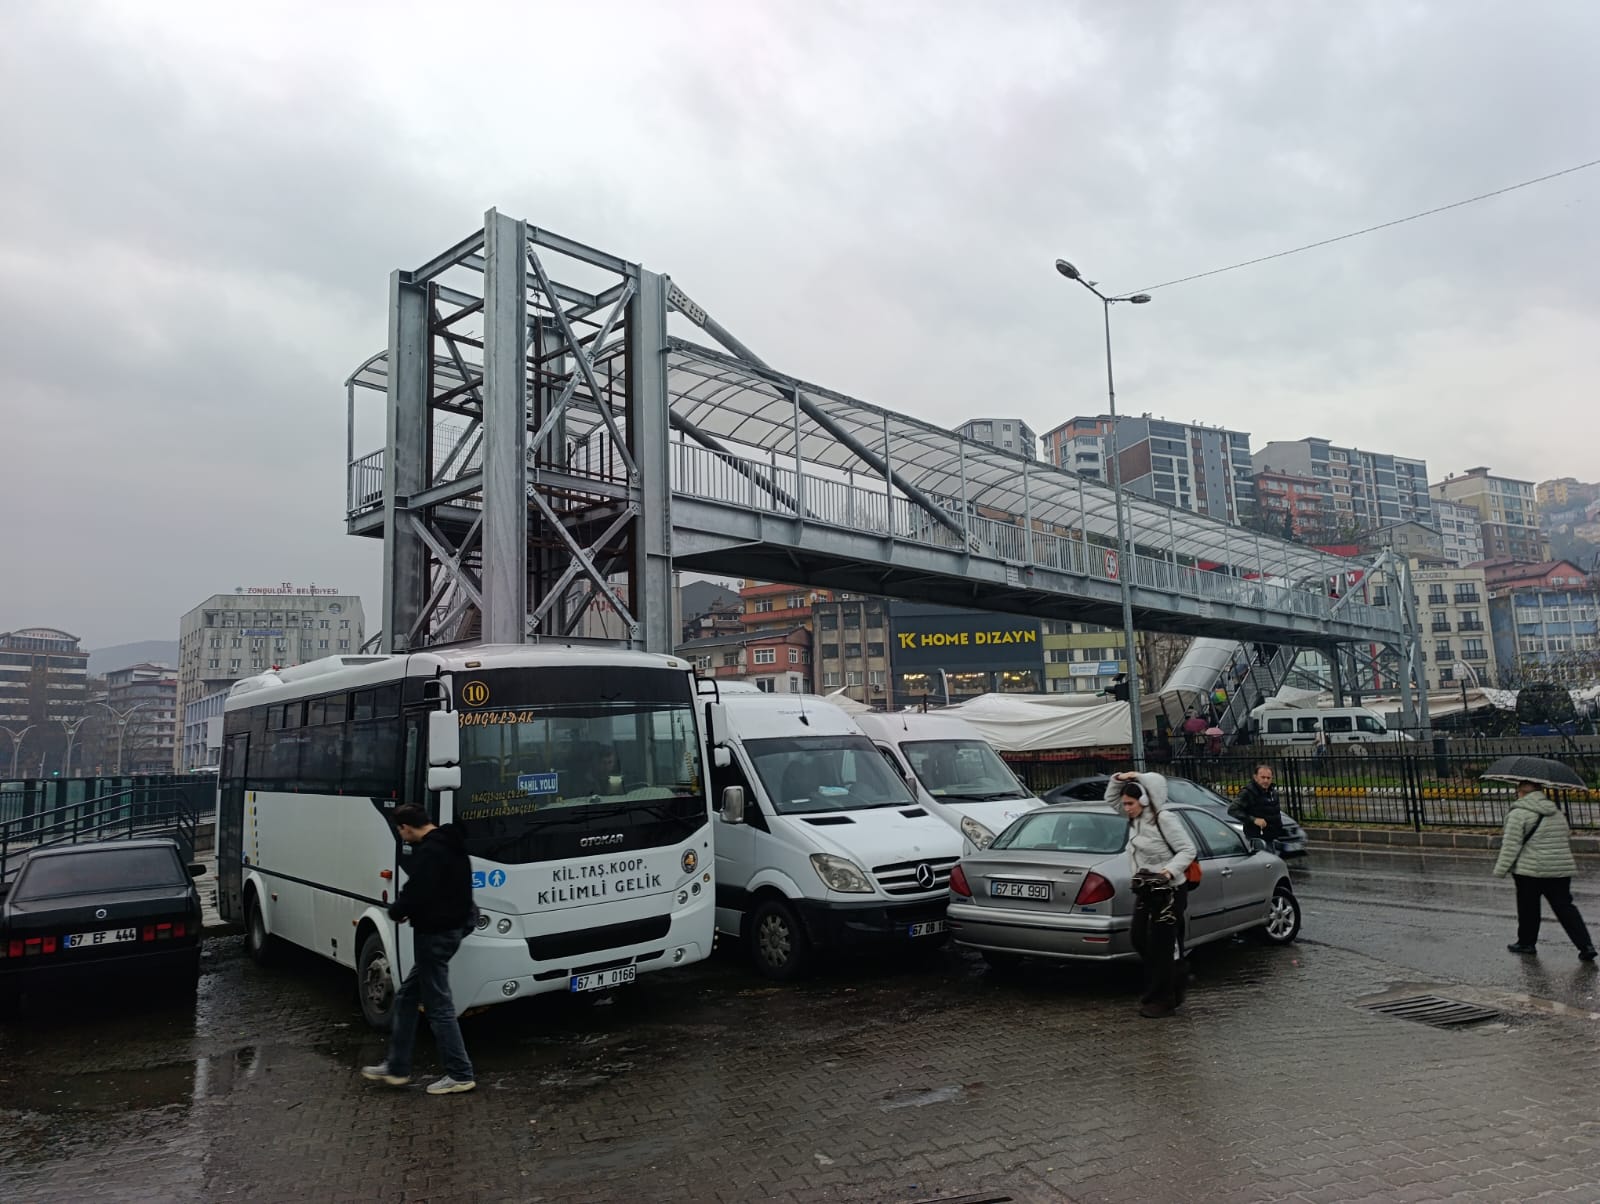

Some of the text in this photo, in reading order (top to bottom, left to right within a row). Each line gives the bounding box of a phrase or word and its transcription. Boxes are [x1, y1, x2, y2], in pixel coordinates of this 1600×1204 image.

[898, 630, 1036, 649] TK HOME DIZAYN
[468, 685, 485, 702] 10
[459, 711, 535, 728] ZONGULDAK
[520, 777, 557, 791] SAHİL YOLU
[580, 833, 624, 847] OTOKAR
[552, 858, 648, 882] KİL.TAŞ.KOOP.
[537, 872, 662, 905] KİLİMLİ GELİK
[996, 883, 1047, 898] 67 EK 990
[70, 929, 135, 946] 67 EF 444
[577, 976, 589, 989] 67
[611, 968, 634, 982] 0166
